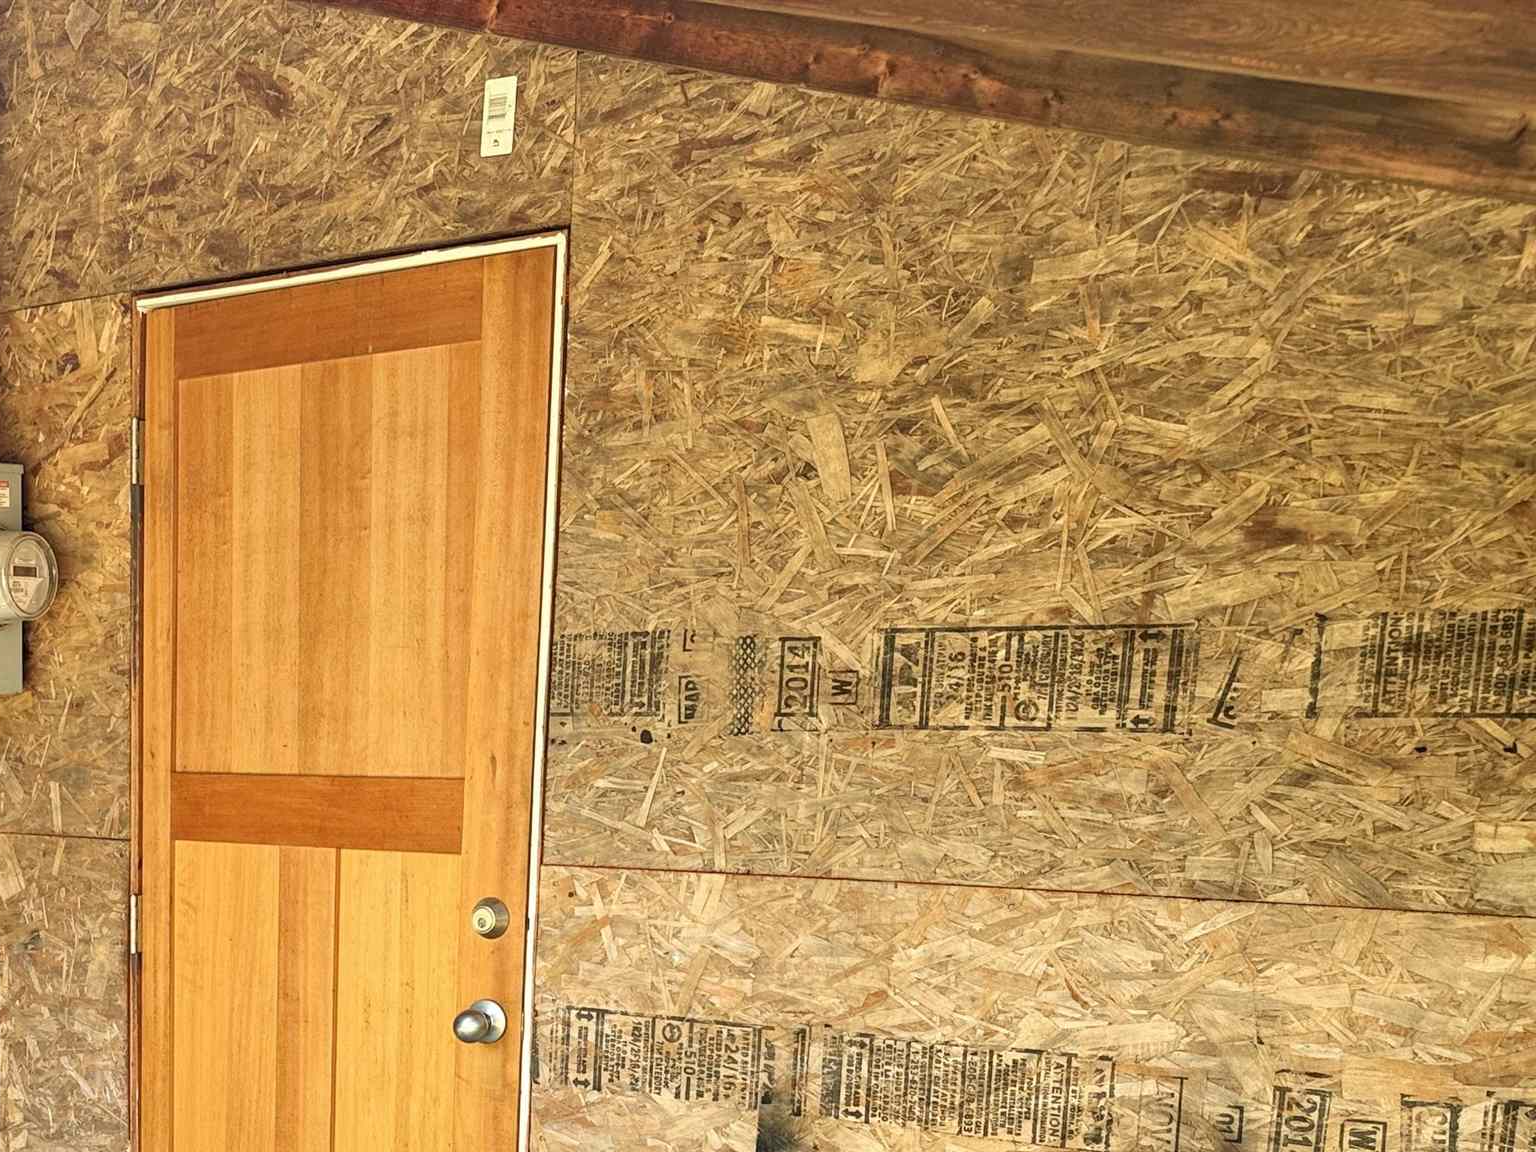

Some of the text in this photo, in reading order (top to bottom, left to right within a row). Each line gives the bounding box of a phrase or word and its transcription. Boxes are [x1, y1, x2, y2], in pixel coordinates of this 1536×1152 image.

[785, 644, 810, 709] 2014
[831, 678, 852, 697] W
[684, 1050, 696, 1076] 510
[1048, 1062, 1065, 1143] ATTENTION:
[1349, 1128, 1378, 1151] W
